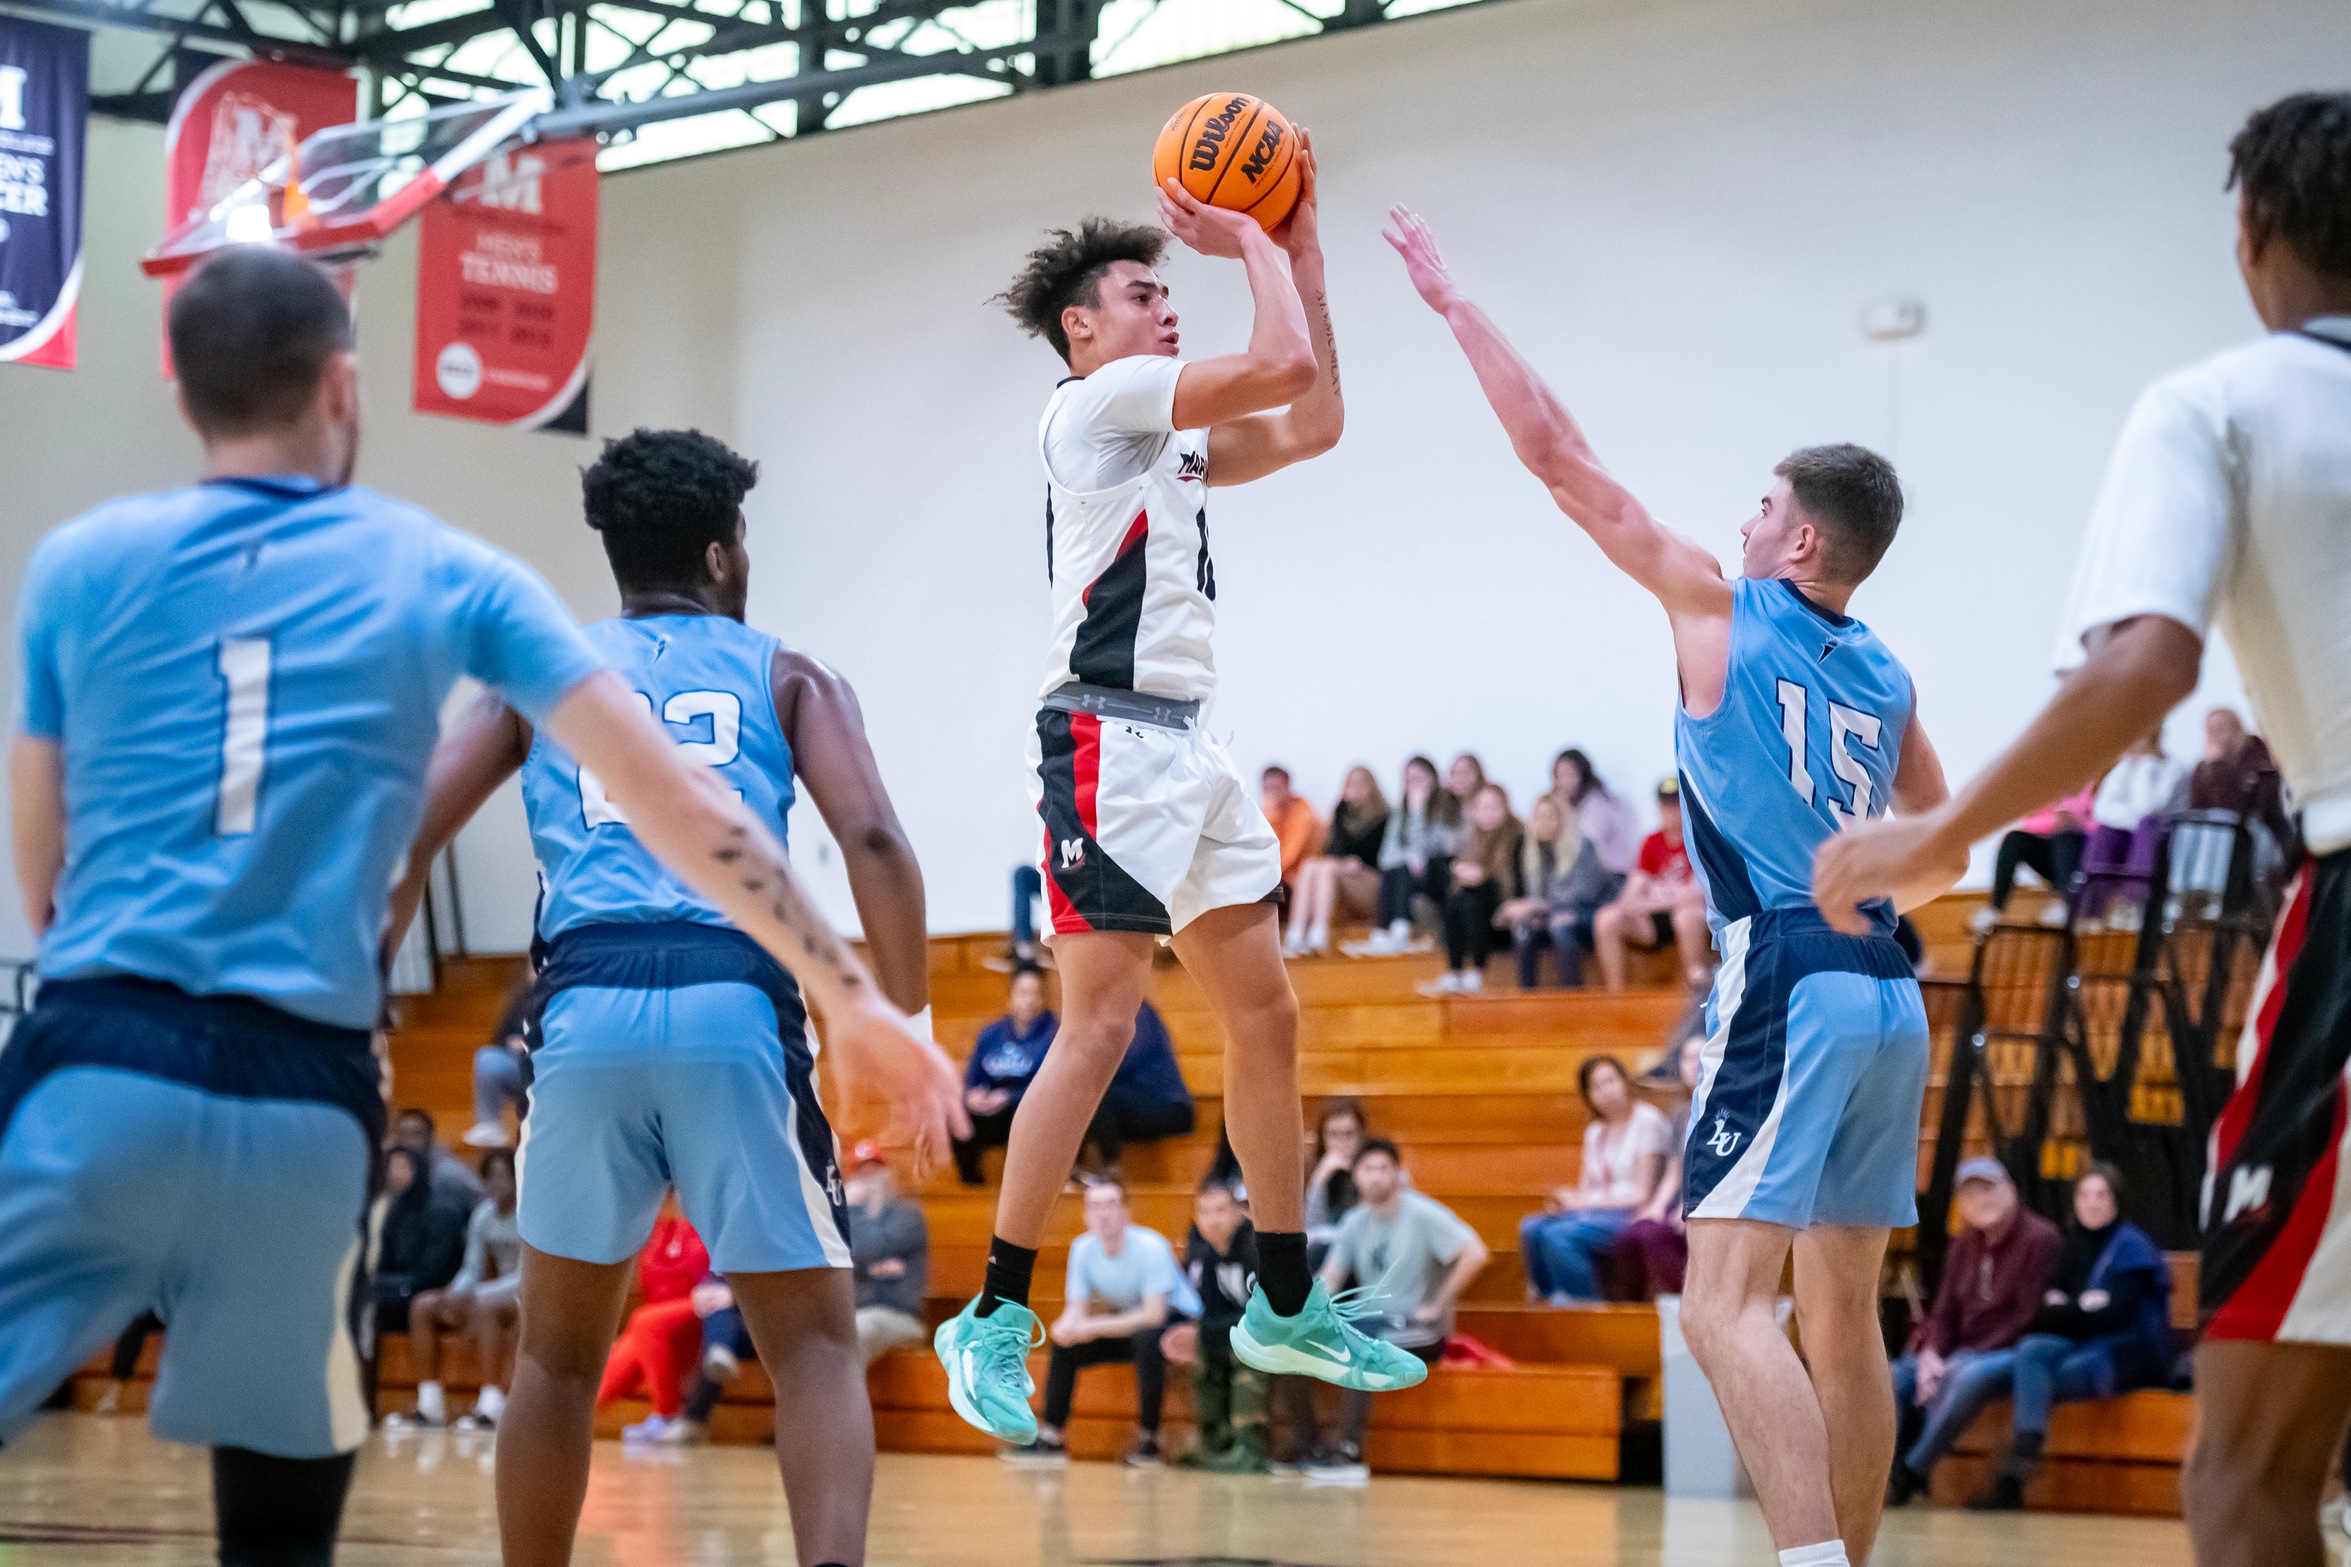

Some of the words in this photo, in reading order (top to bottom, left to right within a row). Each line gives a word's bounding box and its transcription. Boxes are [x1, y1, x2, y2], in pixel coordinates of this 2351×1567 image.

[1189, 97, 1251, 172] Wilson
[1241, 119, 1284, 185] NCAA
[212, 632, 271, 838] 1
[1776, 676, 1883, 828] 15
[1061, 837, 1084, 869] M
[1706, 1117, 1742, 1157] LU
